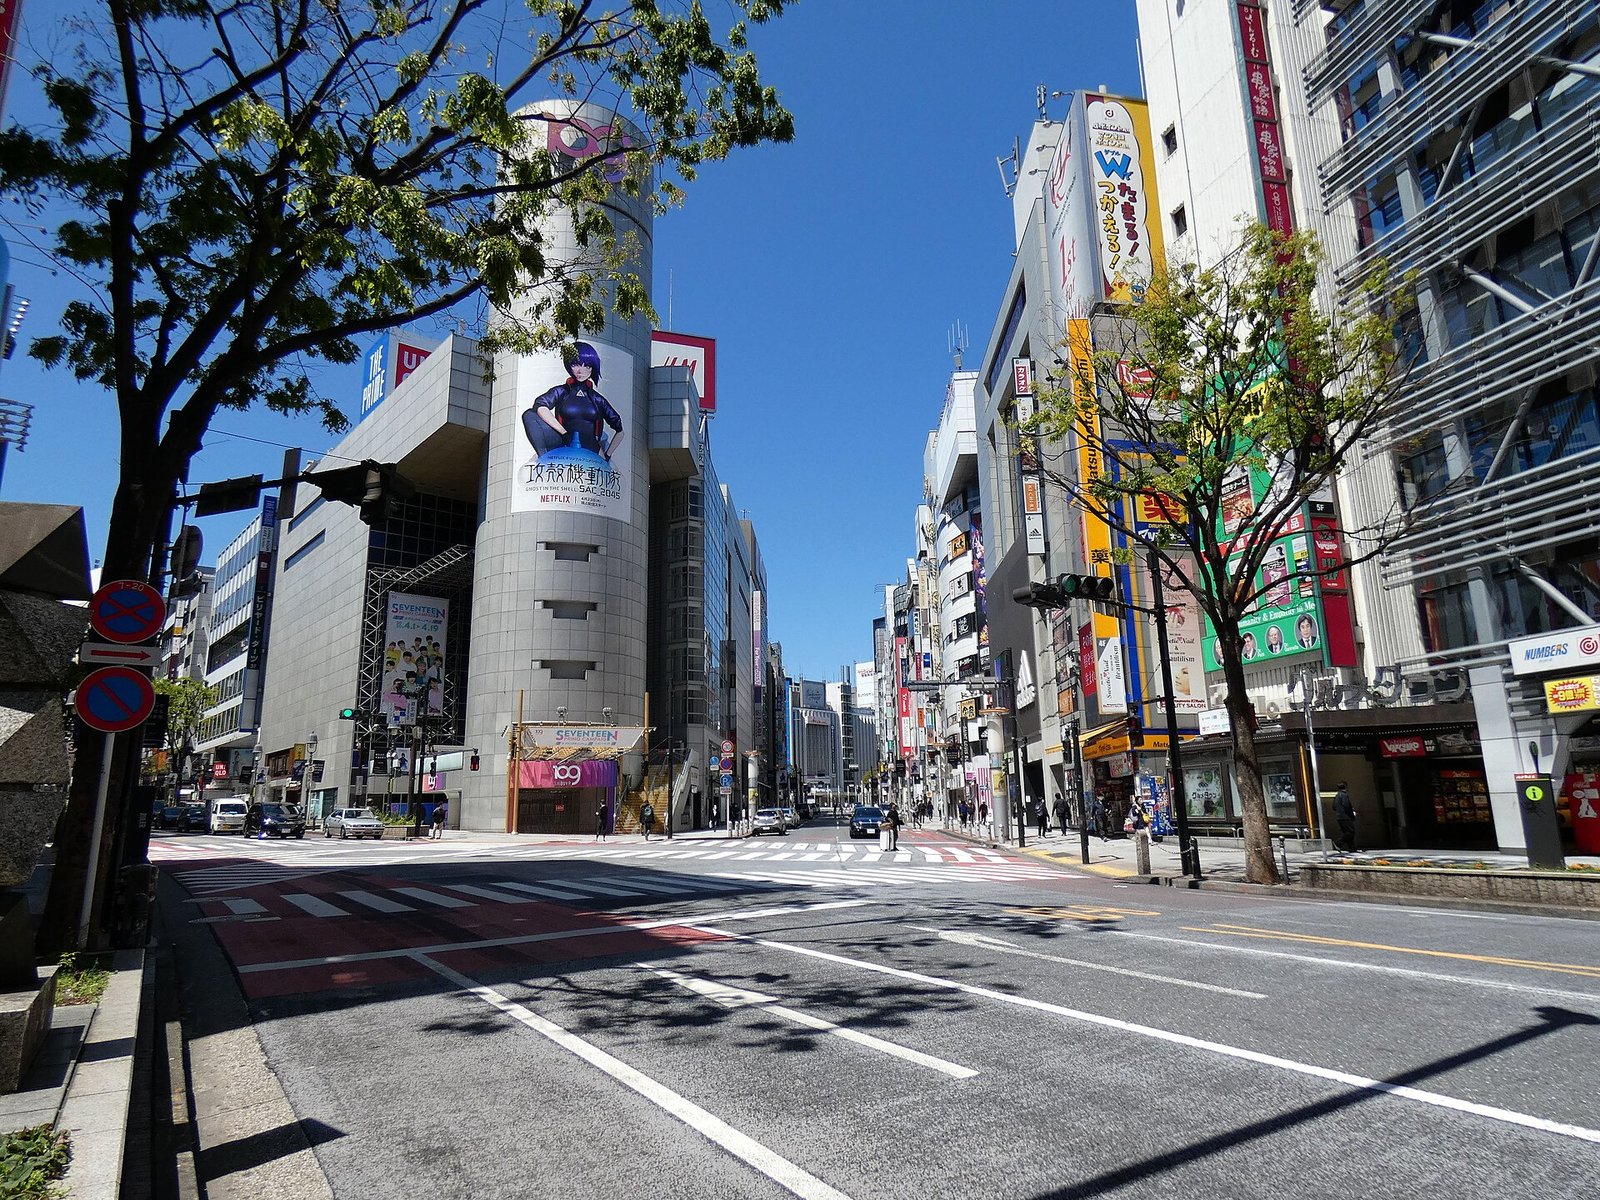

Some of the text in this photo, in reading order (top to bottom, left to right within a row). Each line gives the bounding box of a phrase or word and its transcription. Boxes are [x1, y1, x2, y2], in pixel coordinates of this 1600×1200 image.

[1251, 71, 1270, 116] 串家物語
[1259, 130, 1278, 176] 串家物語
[370, 345, 383, 380] THE
[361, 369, 386, 414] PRIME
[1018, 367, 1026, 392] カラオケ
[524, 462, 621, 491] 攻殻機動隊
[540, 494, 571, 504] NETFLIX
[391, 603, 446, 619] SEVENTEEN
[1524, 643, 1568, 660] NUMBERS
[556, 730, 618, 741] SEVENTEEN
[552, 765, 581, 786] 109
